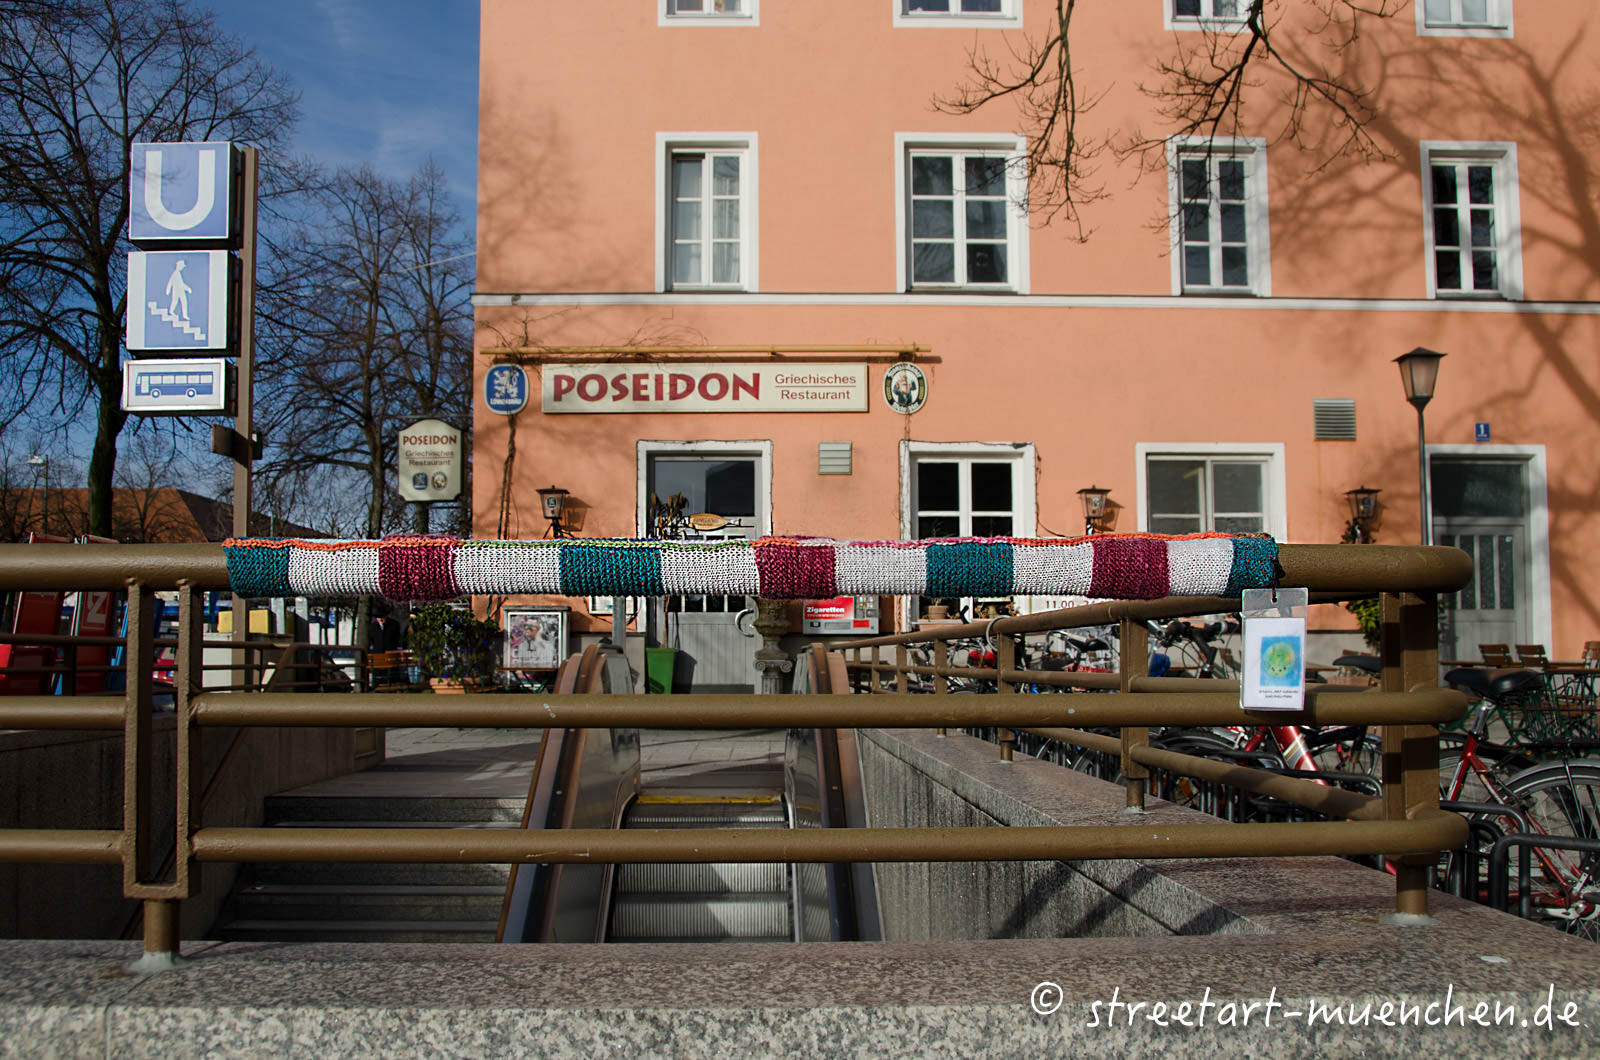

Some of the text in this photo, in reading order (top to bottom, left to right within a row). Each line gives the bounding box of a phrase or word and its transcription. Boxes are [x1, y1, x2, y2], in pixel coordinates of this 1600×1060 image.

[145, 149, 215, 230] U
[775, 374, 856, 385] Griechisches
[553, 373, 760, 402] POSEIDON
[781, 389, 850, 400] Restaurant
[403, 435, 457, 445] POSEIDON
[806, 606, 845, 614] Zigaretten
